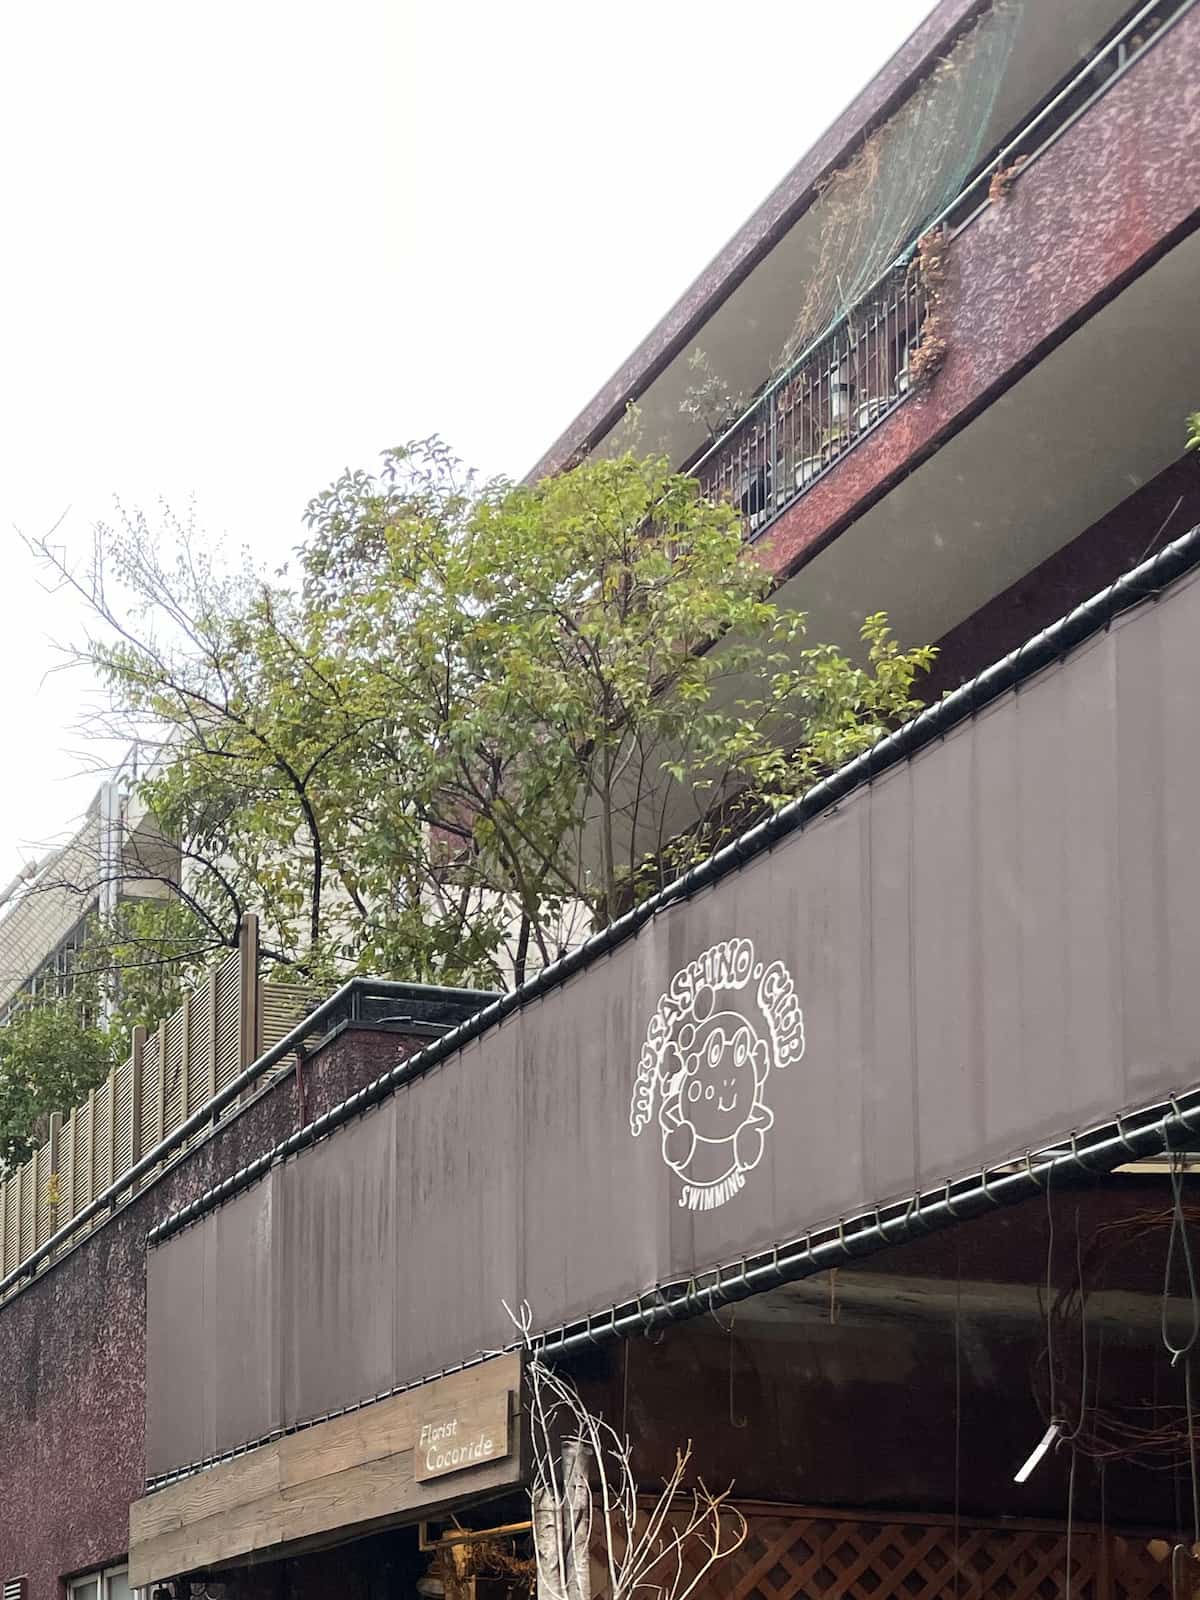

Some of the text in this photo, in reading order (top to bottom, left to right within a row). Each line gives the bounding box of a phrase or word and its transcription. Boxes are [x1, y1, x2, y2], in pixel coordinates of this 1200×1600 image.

[757, 960, 805, 1068] CLUB
[678, 1169, 747, 1211] SWIMMING
[419, 1418, 458, 1447] Florist
[426, 1433, 494, 1471] Cocoride
